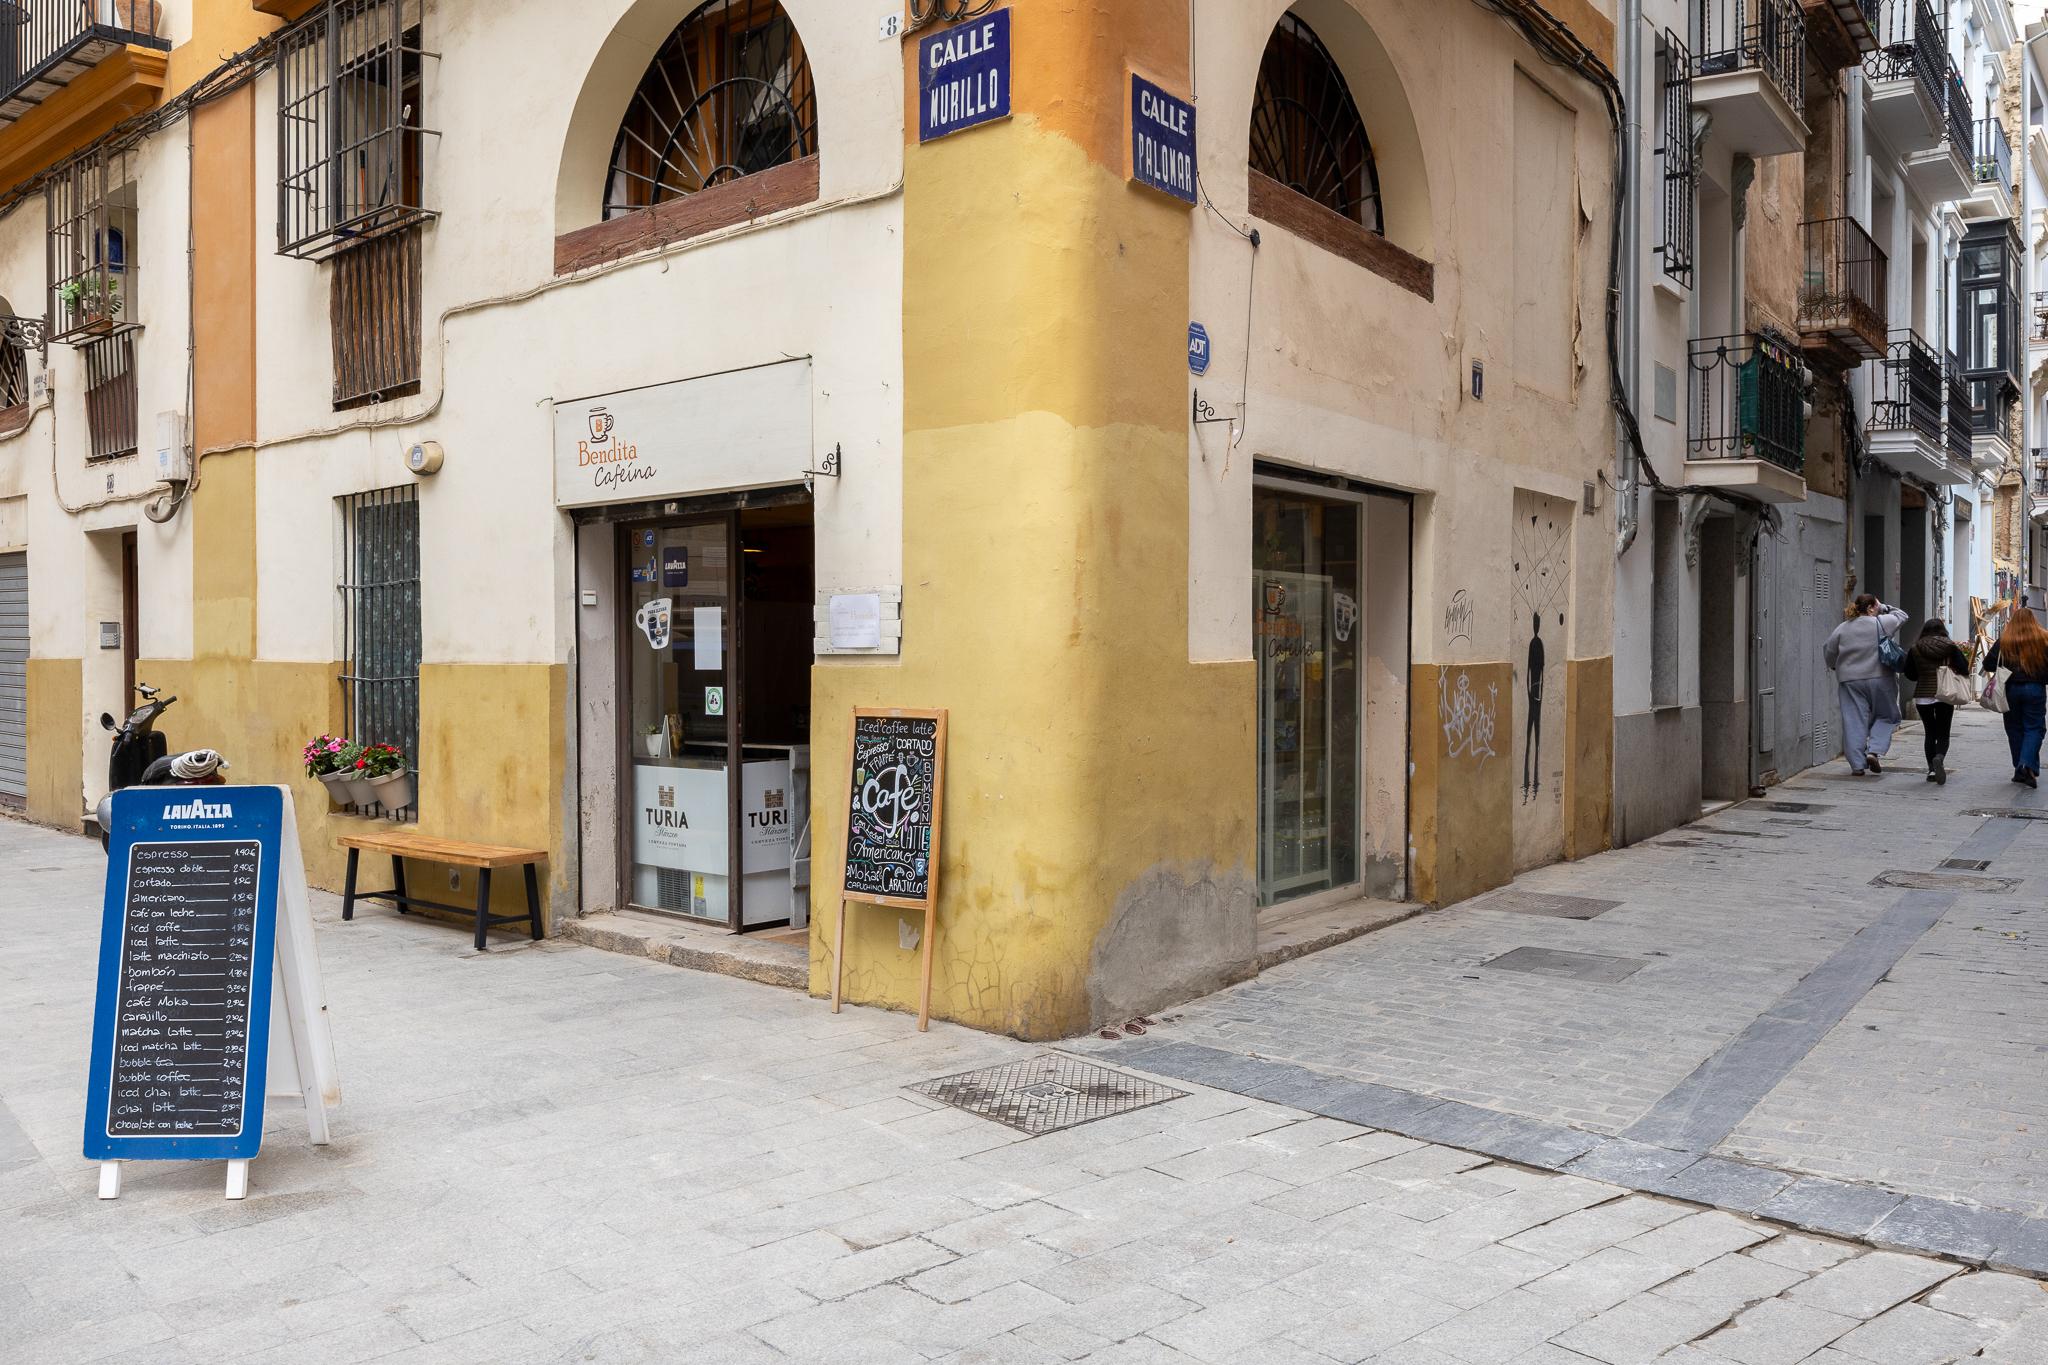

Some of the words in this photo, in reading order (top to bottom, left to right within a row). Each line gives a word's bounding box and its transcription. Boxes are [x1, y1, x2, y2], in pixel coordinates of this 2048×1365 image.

[887, 16, 897, 36] 8
[930, 22, 994, 68] CALLE
[930, 68, 998, 128] MURILLO
[1142, 90, 1188, 136] CALLE
[1138, 132, 1192, 192] PALOMAR
[1189, 337, 1206, 356] ADT
[578, 436, 638, 467] Bendita
[594, 462, 657, 490] Cafeína
[858, 719, 880, 734] Iced
[882, 721, 909, 734] coffee
[912, 721, 933, 735] latte
[856, 742, 890, 764] Espresso
[896, 738, 933, 754] CORTADO
[162, 798, 232, 820] LAVAZZA
[862, 764, 920, 838] Café
[646, 808, 688, 829] TURIA
[748, 809, 788, 828] TURI
[900, 826, 929, 850] LATTE
[137, 851, 188, 860] espresso
[854, 843, 916, 863] Americano
[136, 866, 175, 874] espresso
[848, 864, 878, 882] Moka
[134, 878, 172, 888] cortado
[882, 866, 922, 894] CARAJILLO
[132, 894, 185, 902] americano
[130, 908, 150, 917] café
[170, 908, 194, 917] leche
[130, 924, 149, 932] iced
[130, 938, 148, 946] iced
[156, 936, 180, 946] latte
[130, 951, 152, 961] latte
[158, 951, 210, 960] macchiato
[128, 966, 176, 977] bombón
[126, 979, 164, 992] frappé
[126, 996, 151, 1008] café
[158, 996, 188, 1006] Moka
[122, 1011, 167, 1022] carajillo
[122, 1028, 160, 1036] matcha
[168, 1026, 192, 1036] latte
[120, 1043, 138, 1052] iced
[142, 1042, 178, 1051] matcha
[184, 1042, 202, 1050] latte
[120, 1058, 152, 1068] bubble
[155, 1056, 174, 1066] tea
[119, 1072, 151, 1082] bubble
[156, 1070, 190, 1082] coffee
[118, 1088, 140, 1097] iced
[144, 1087, 171, 1098] chai
[180, 1086, 202, 1096] latte
[152, 1102, 176, 1112] latte
